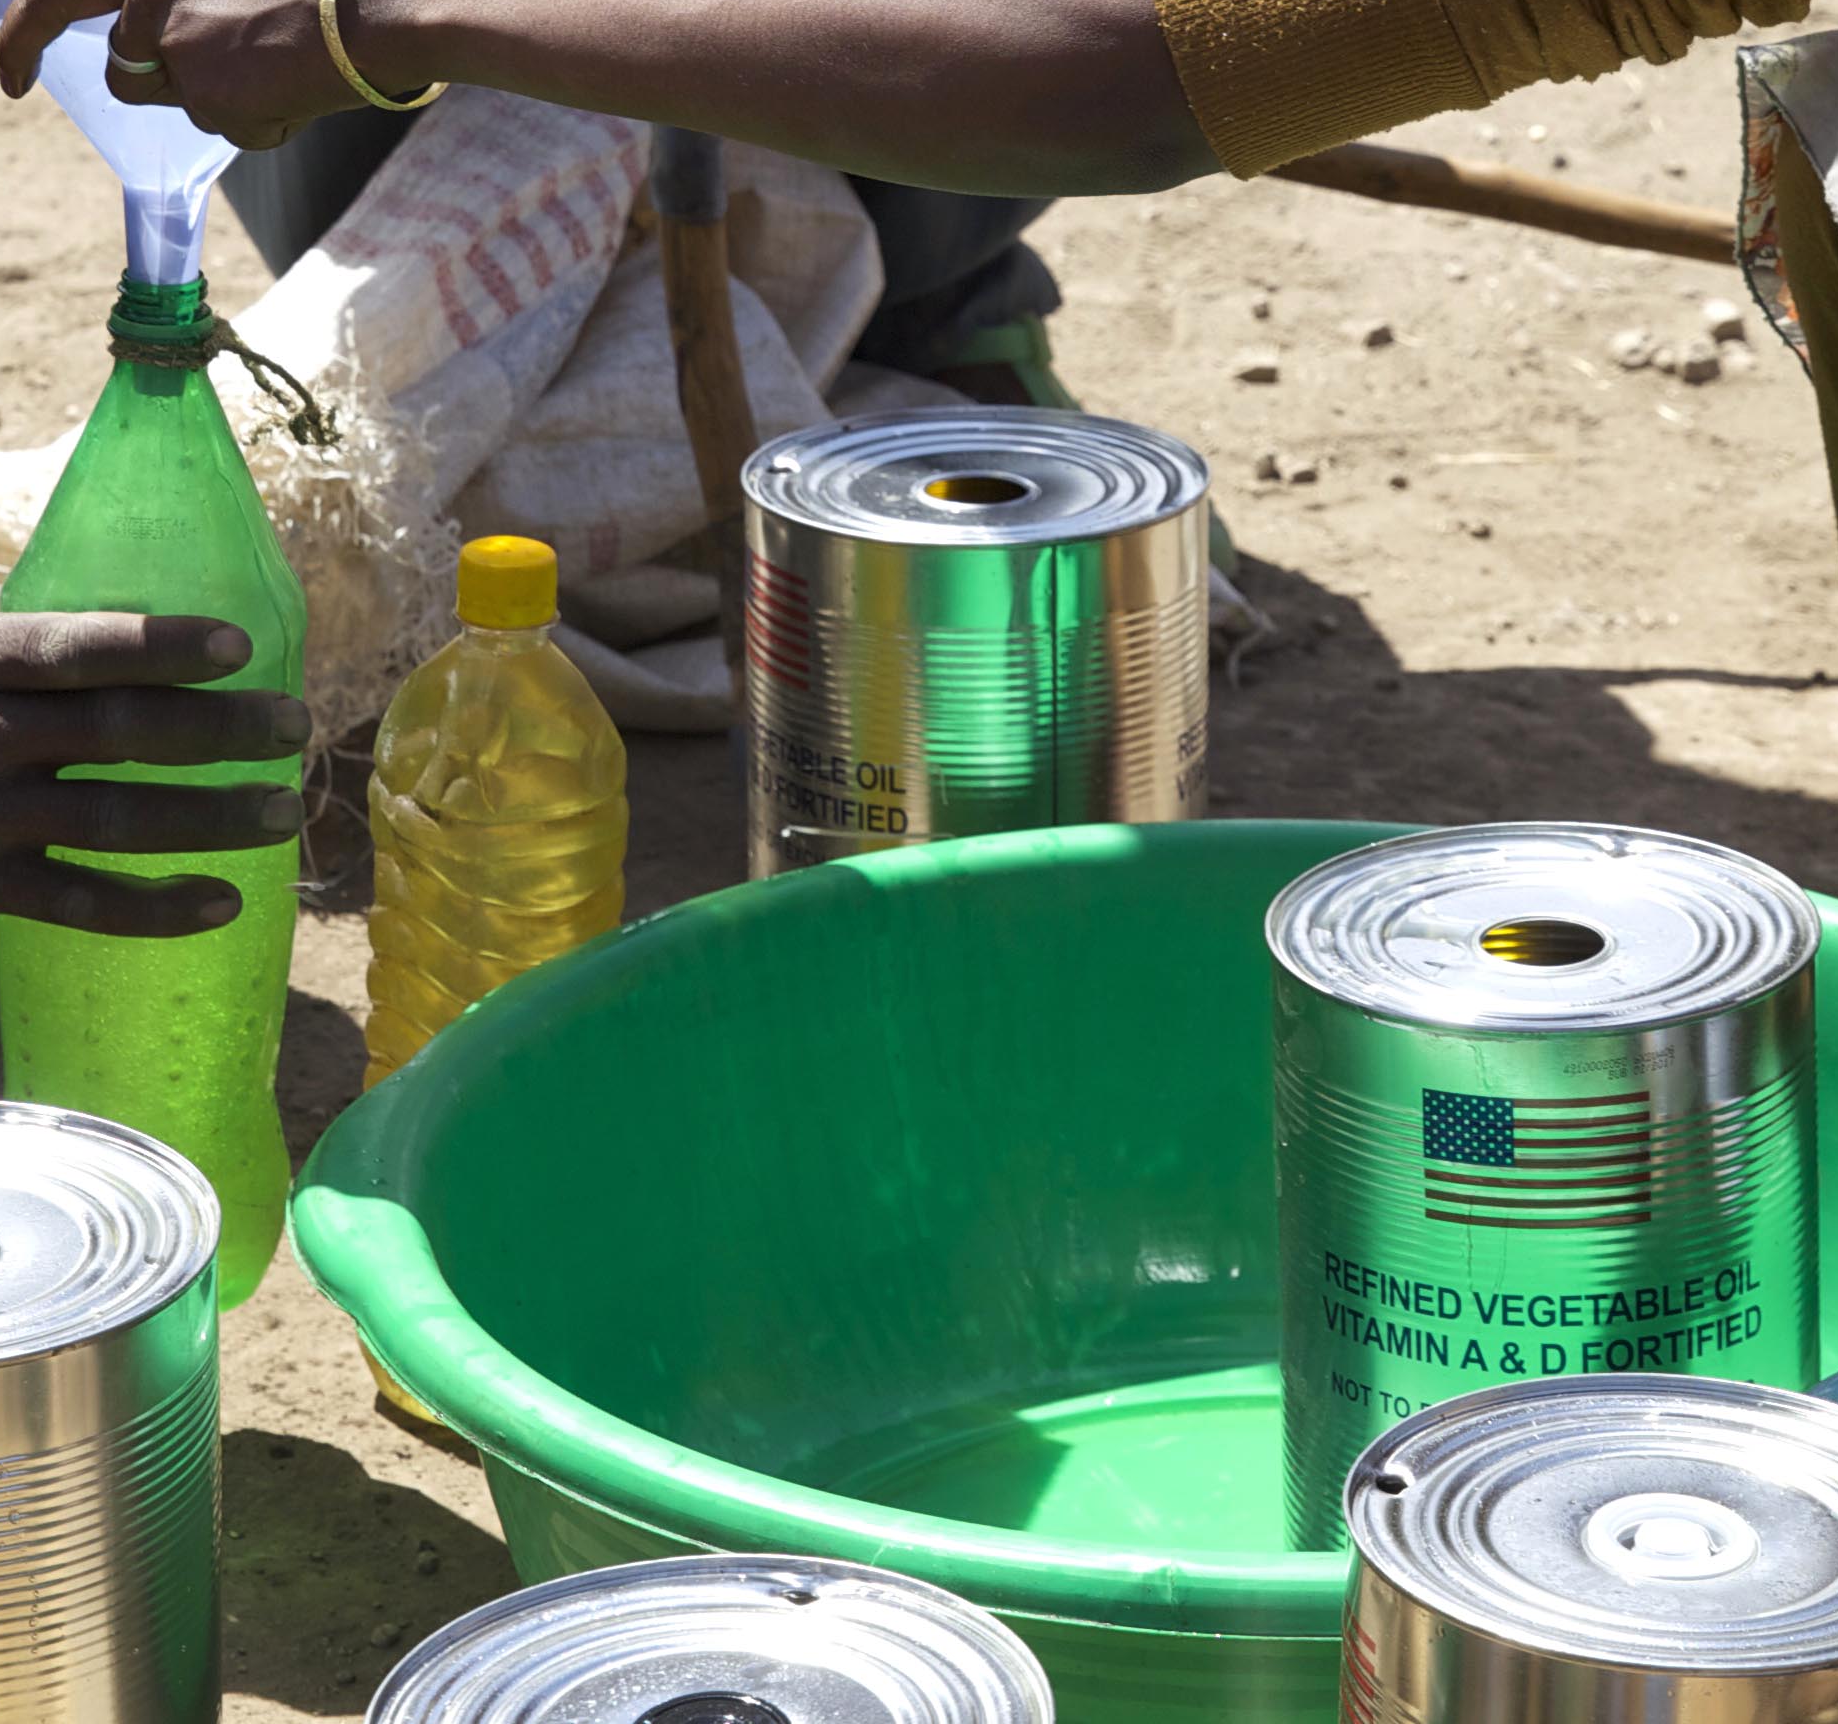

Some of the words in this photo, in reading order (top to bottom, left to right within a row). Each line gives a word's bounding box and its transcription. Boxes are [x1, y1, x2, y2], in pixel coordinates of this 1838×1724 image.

[775, 773, 908, 835] FORTIFIED
[856, 761, 907, 795] OIL
[1326, 1251, 1463, 1320] REFINED
[1471, 1282, 1705, 1327] VEGETABLE
[1714, 1262, 1761, 1302] OIL
[1323, 1294, 1449, 1368] VITAMIN
[1460, 1341, 1488, 1373] A
[1499, 1340, 1527, 1375] &
[1541, 1344, 1567, 1375] D
[1582, 1304, 1762, 1374] FORTIFIED
[1331, 1371, 1372, 1408] NOT
[1379, 1391, 1411, 1419] TO
